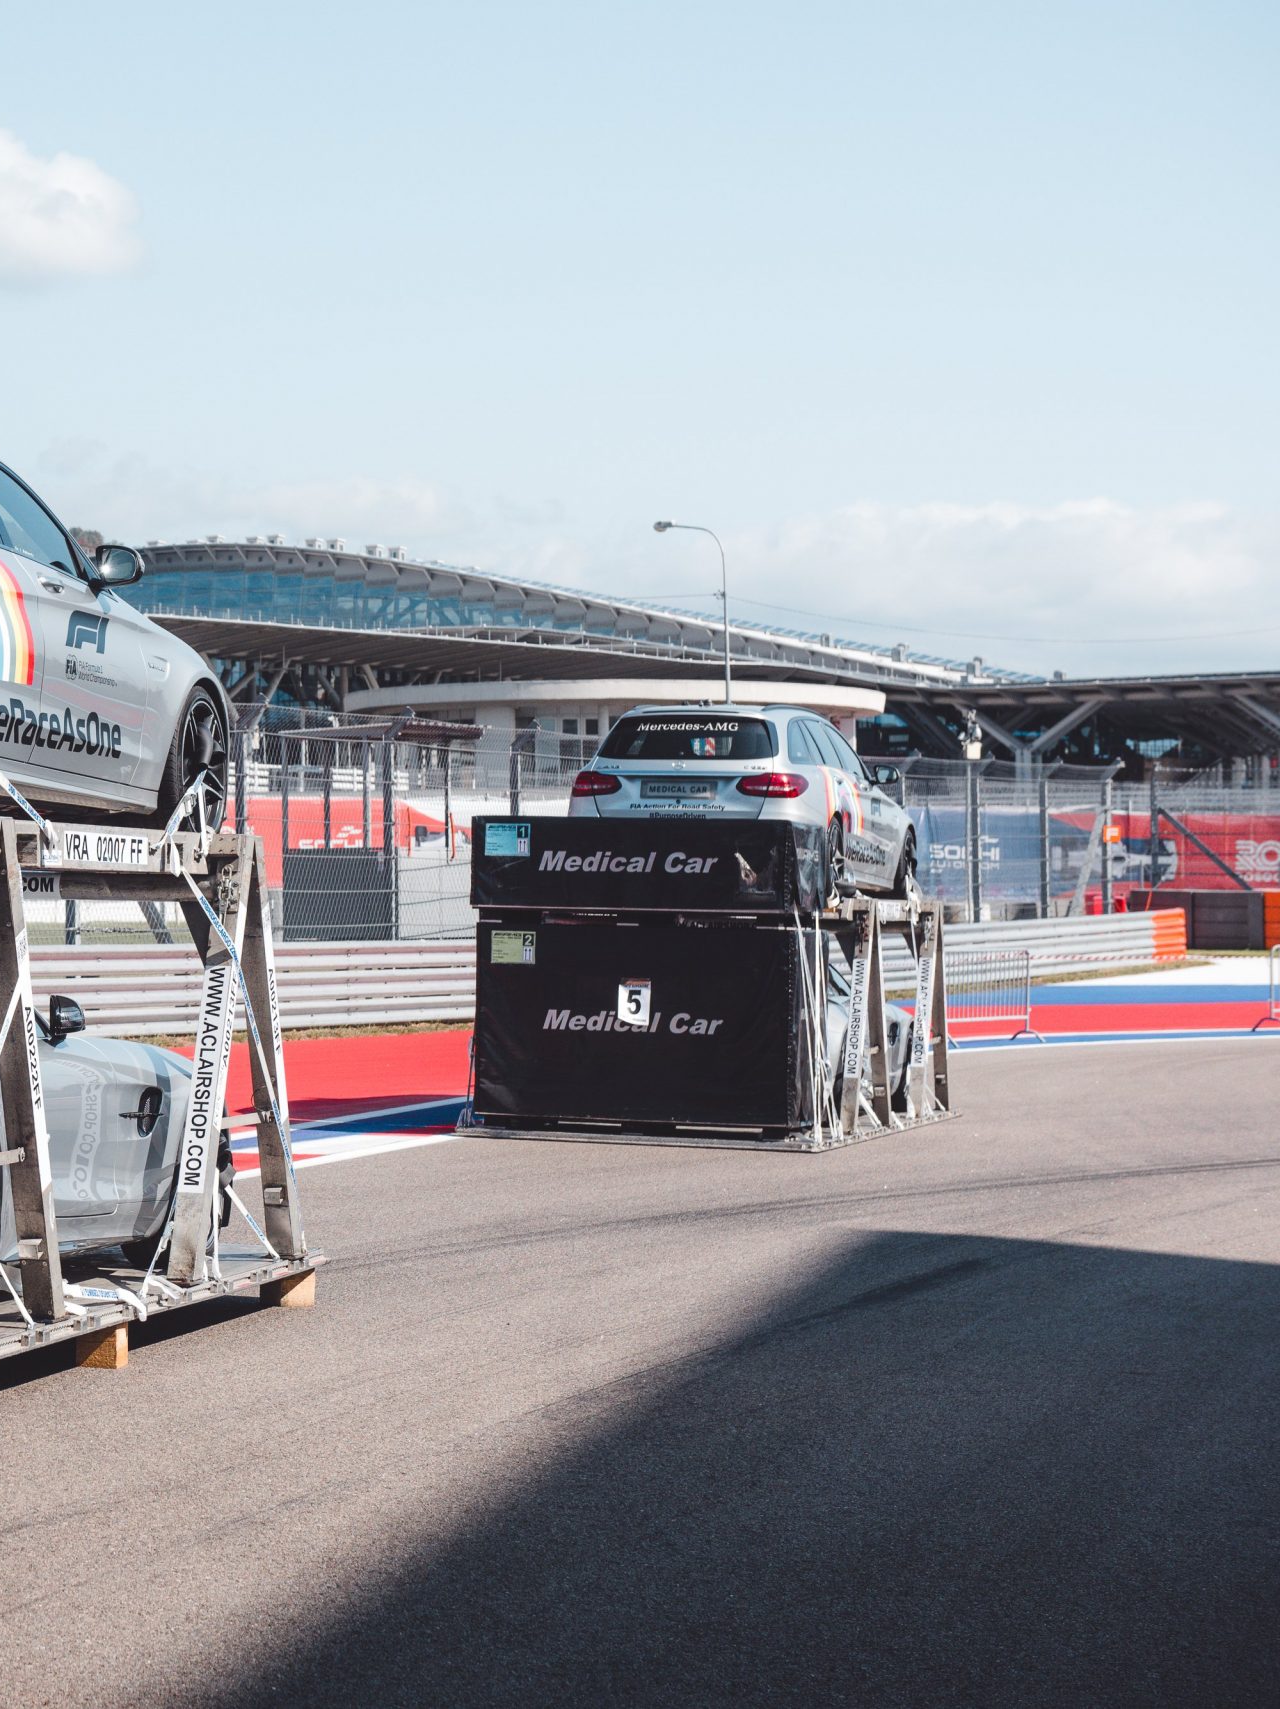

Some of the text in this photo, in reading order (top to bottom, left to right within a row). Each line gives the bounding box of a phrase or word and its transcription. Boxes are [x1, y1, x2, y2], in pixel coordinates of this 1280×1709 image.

[65, 659, 78, 676] FIA
[637, 722, 739, 732] Mercedes-AMG
[648, 785, 708, 794] MEDICAL CAR
[520, 826, 526, 837] 1
[1106, 827, 1119, 841] F
[65, 832, 90, 861] VRA
[96, 835, 126, 863] 02007
[130, 838, 144, 864] FF
[538, 850, 719, 875] Medical Car
[524, 934, 533, 946] 2
[627, 989, 642, 1015] 5
[669, 1012, 723, 1036] Car
[846, 960, 865, 1075] WWW.ACLAIRSHOP.COM
[24, 1006, 42, 1111] A00222FF
[183, 967, 226, 1186] WWW.ACLAIRSHOP.COM
